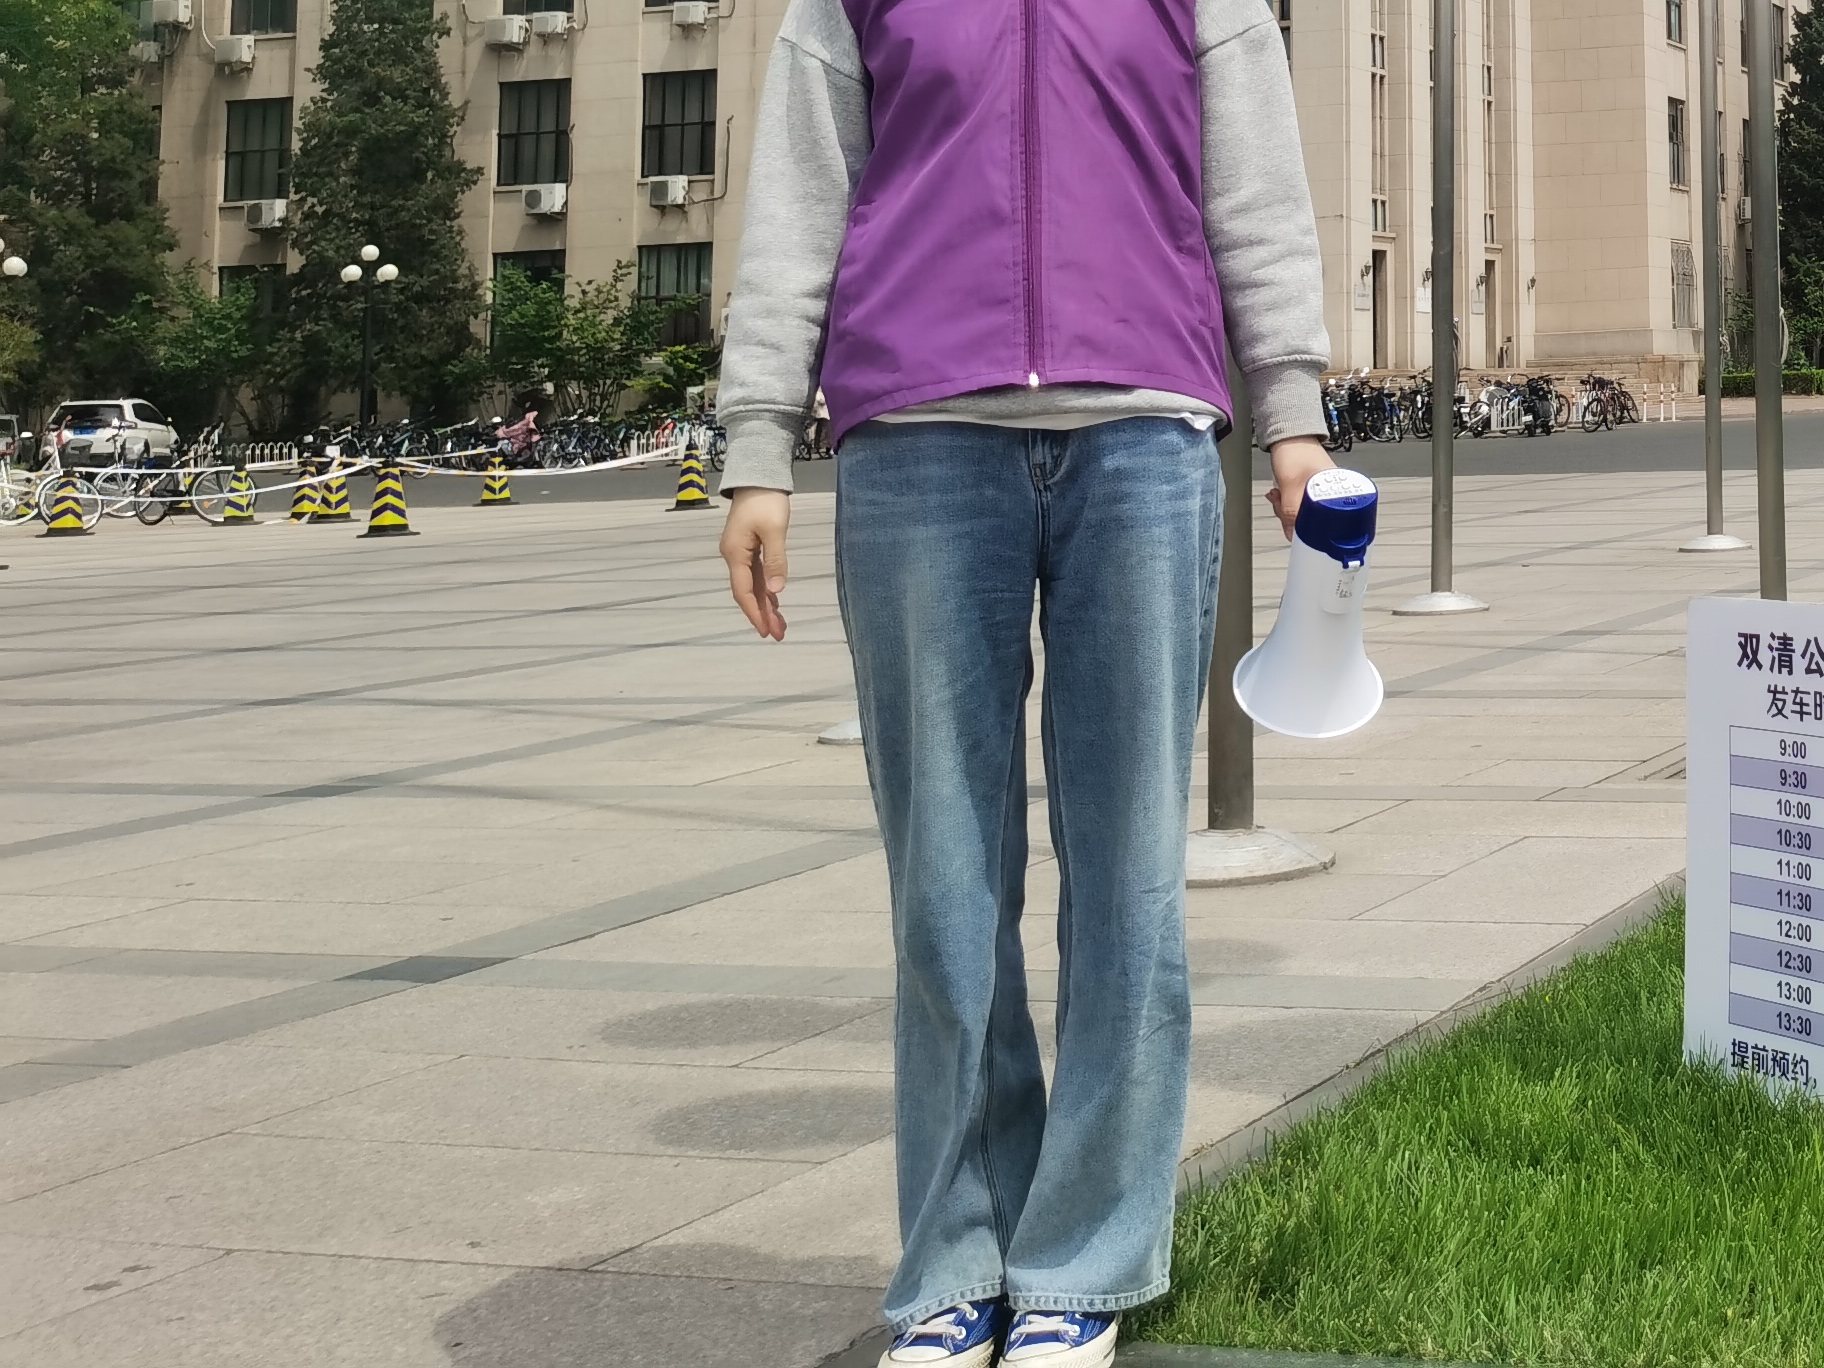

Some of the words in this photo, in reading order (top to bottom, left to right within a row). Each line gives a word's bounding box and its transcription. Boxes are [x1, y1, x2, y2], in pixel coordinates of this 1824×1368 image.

[1779, 739, 1808, 760] 9:00
[1777, 770, 1809, 790] 9:30
[1777, 800, 1809, 821] 10:00
[1777, 830, 1809, 852] 10:30
[1777, 861, 1810, 882] 11:00
[1777, 891, 1810, 913] 11:30
[1777, 921, 1811, 944] 12:00
[1777, 951, 1811, 975] 12:30
[1777, 982, 1811, 1005] 13:00
[1777, 1012, 1812, 1036] 13:30
